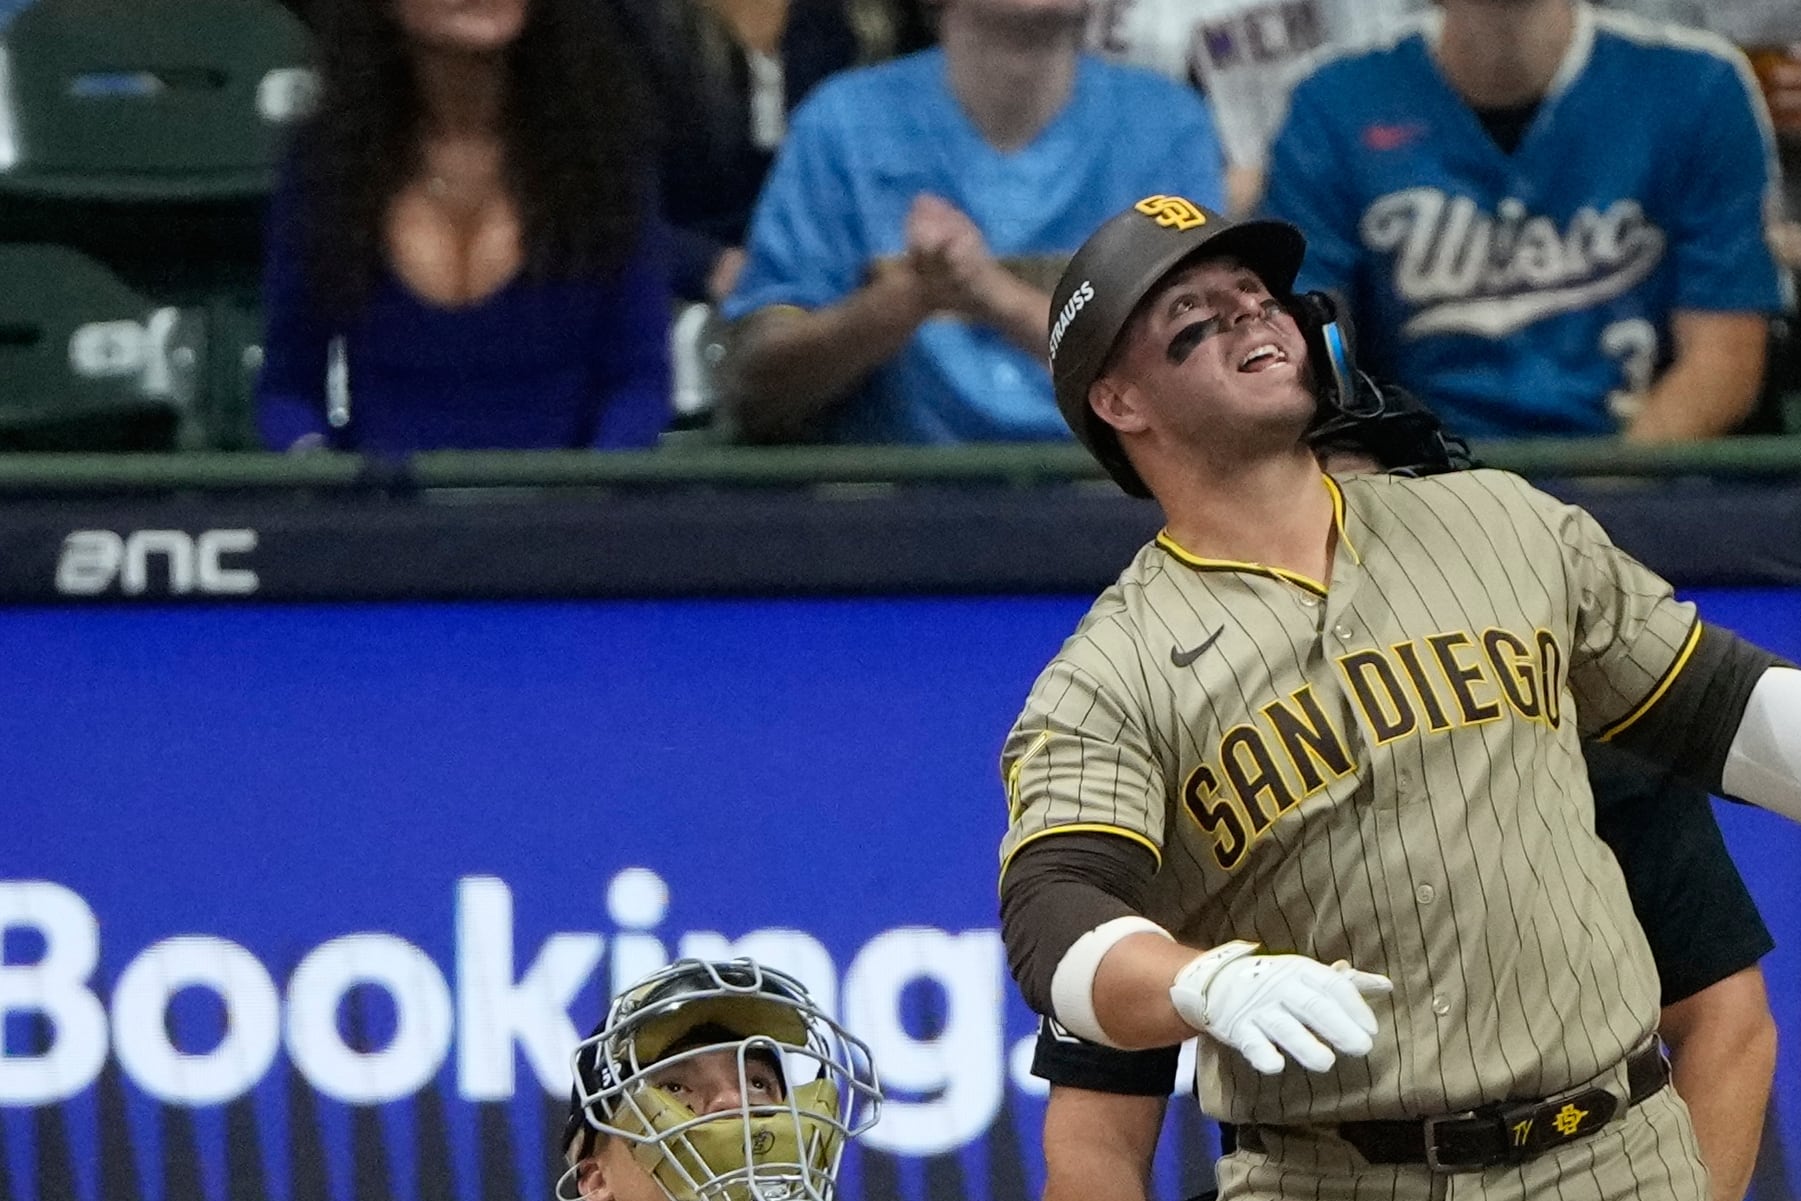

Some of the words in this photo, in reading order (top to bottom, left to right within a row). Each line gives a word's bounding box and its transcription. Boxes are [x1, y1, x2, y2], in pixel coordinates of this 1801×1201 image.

[1135, 194, 1207, 232] SD
[1049, 280, 1095, 361] STRAUSS
[55, 528, 260, 595] anc
[1181, 682, 1358, 871] SAN
[1336, 625, 1563, 747] DIEGO
